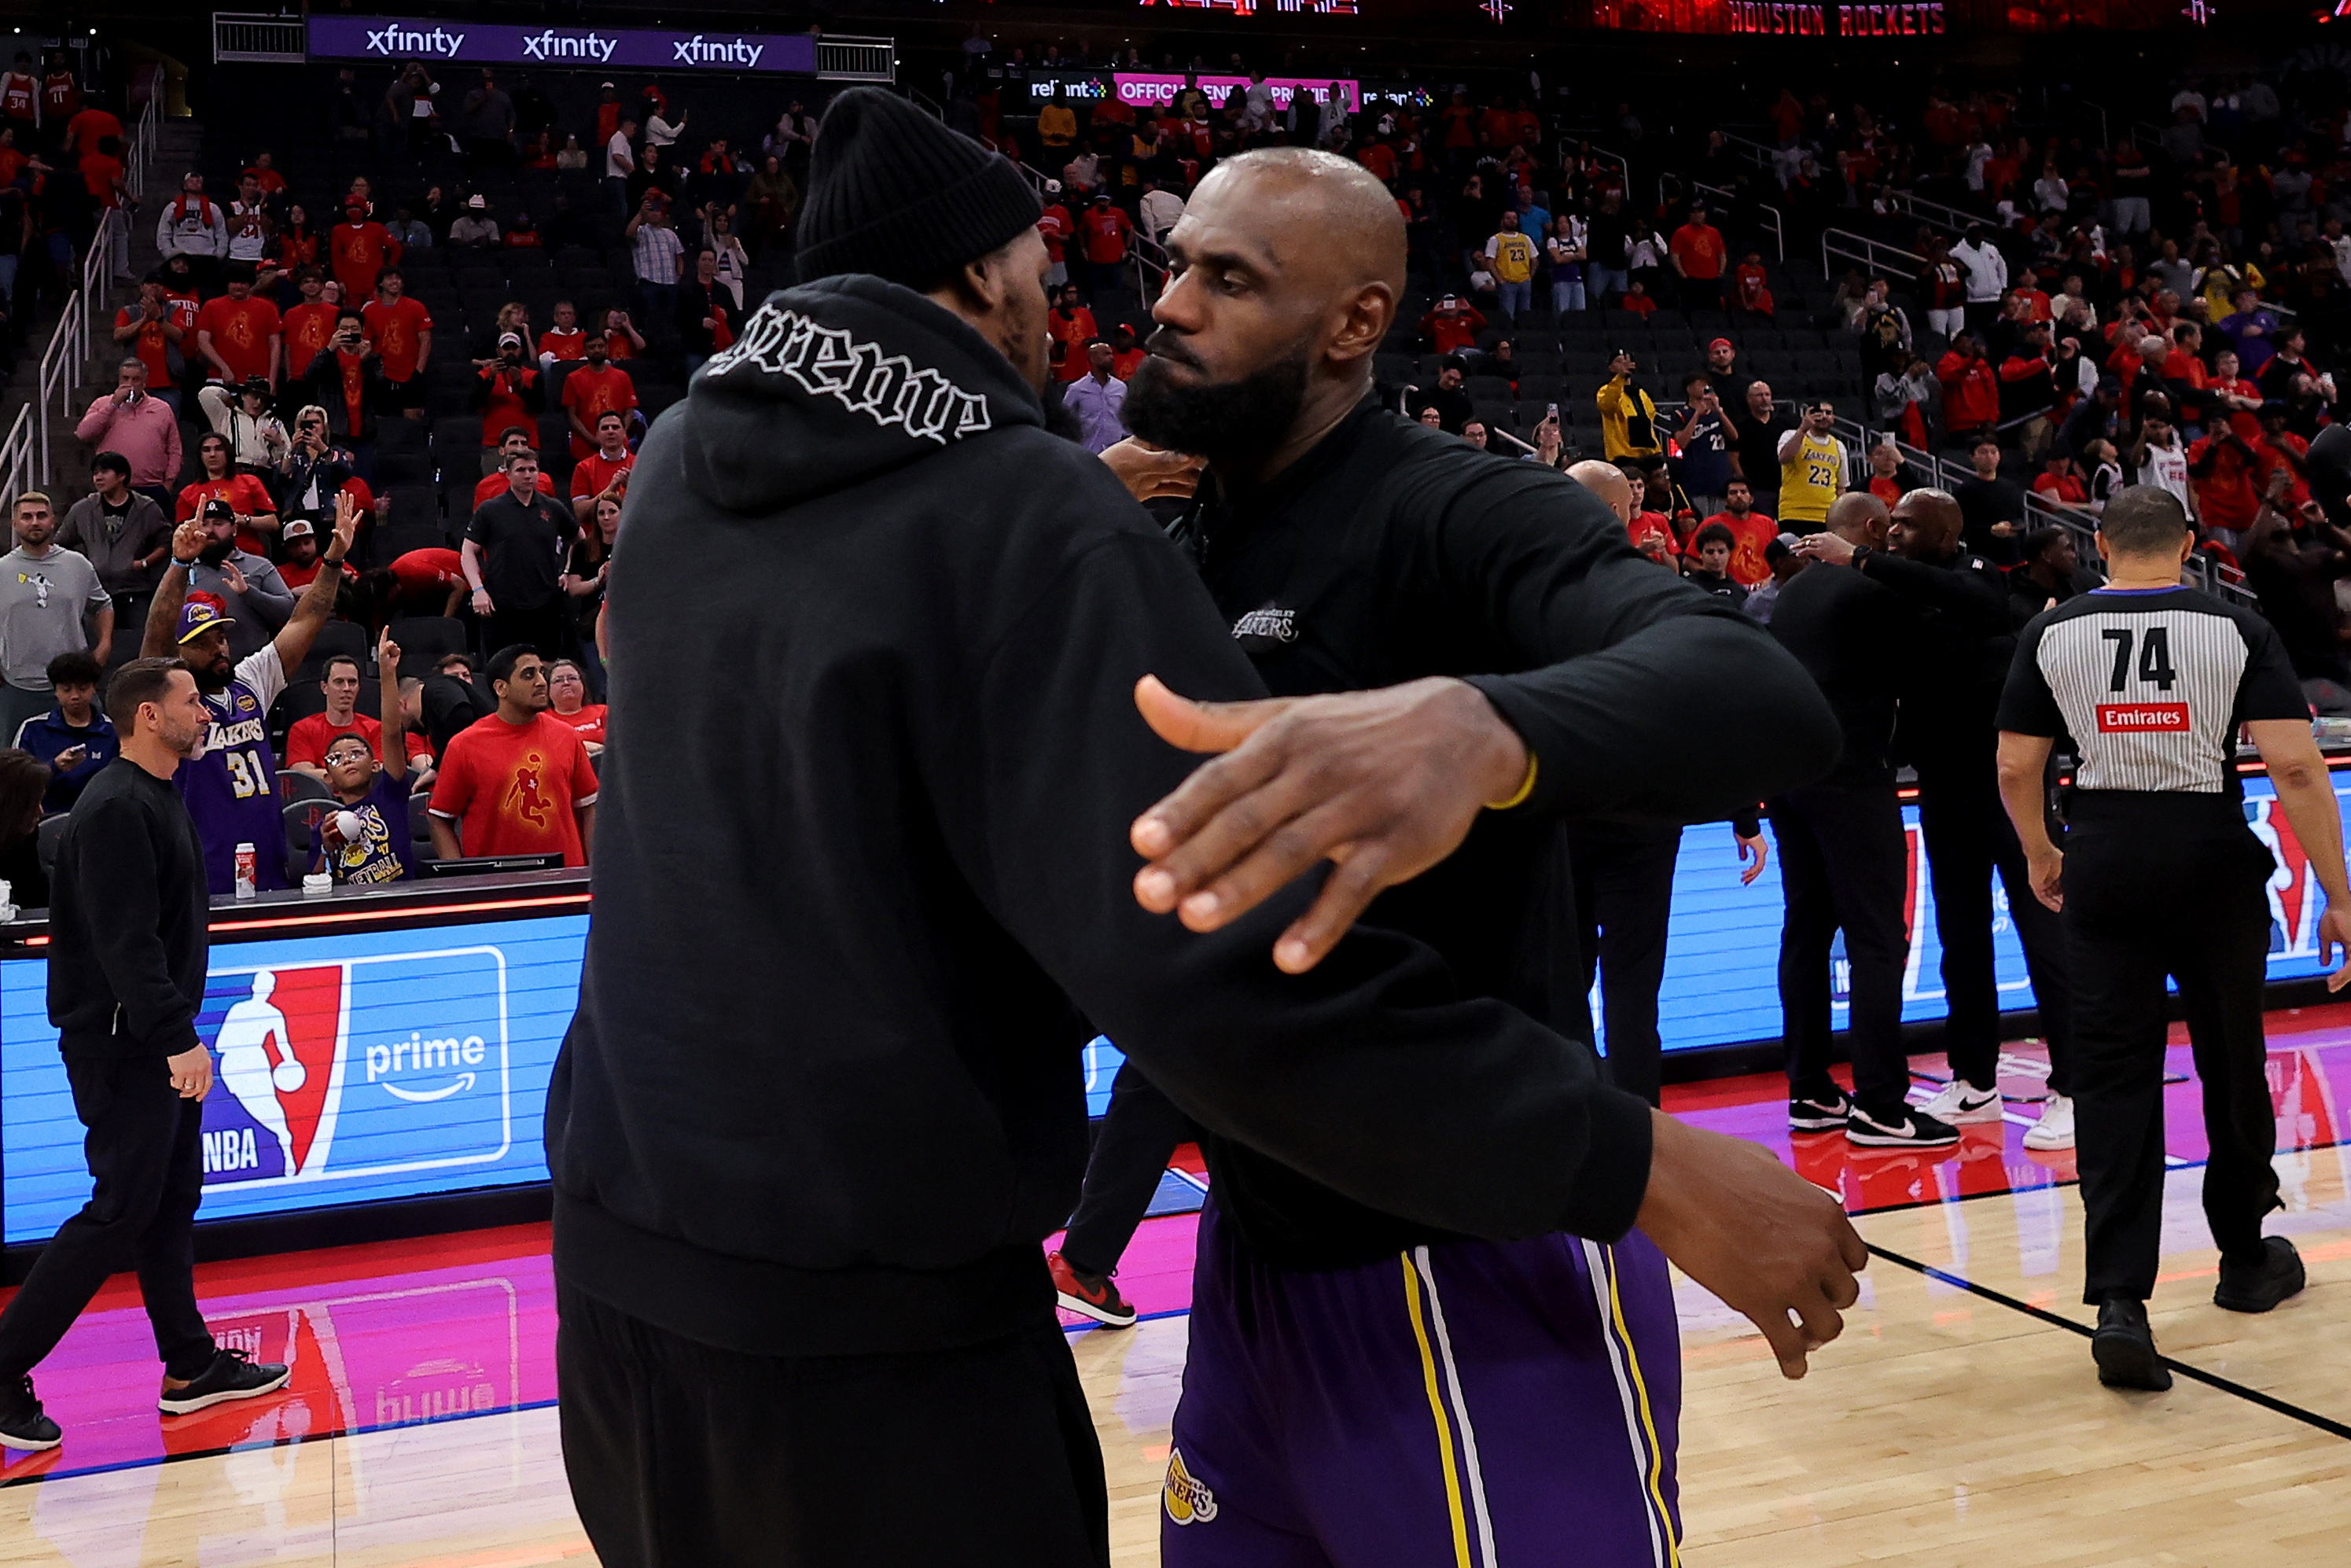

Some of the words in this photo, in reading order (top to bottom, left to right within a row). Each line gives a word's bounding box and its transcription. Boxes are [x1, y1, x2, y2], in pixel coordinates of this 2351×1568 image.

[1730, 1, 1824, 35] HOUSTON
[1838, 3, 1944, 36] ROCKETS
[366, 24, 465, 57] xfinity
[523, 30, 618, 62] xfinity
[672, 35, 764, 67] xfinity
[1032, 79, 1090, 98] relnt
[1510, 249, 1525, 263] 23
[1808, 464, 1831, 488] 23
[2102, 628, 2176, 692] 74
[200, 717, 265, 752] LAKERS
[2104, 709, 2181, 727] Emirates
[226, 749, 270, 799] 31
[366, 1032, 485, 1083] prime
[202, 1128, 259, 1173] NBA
